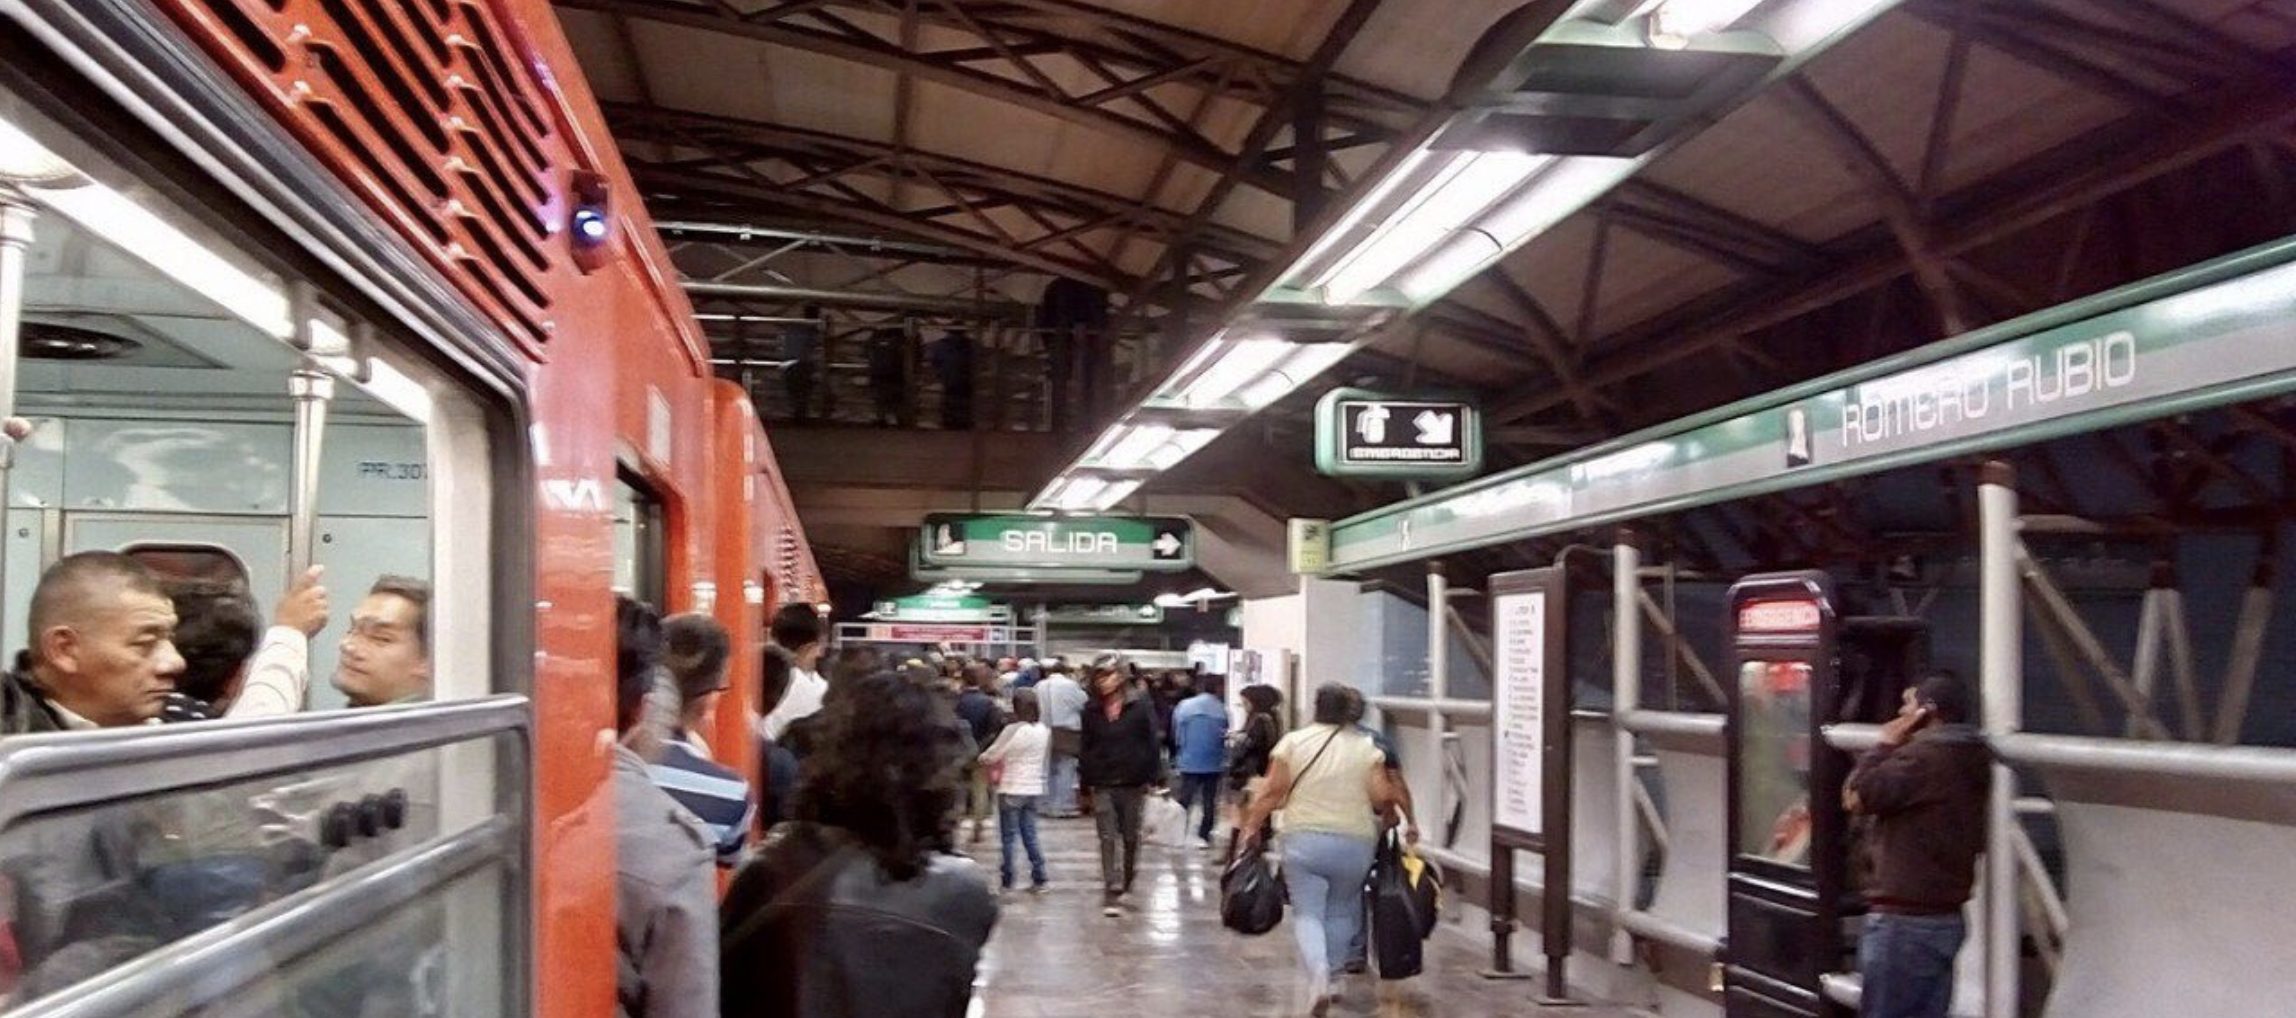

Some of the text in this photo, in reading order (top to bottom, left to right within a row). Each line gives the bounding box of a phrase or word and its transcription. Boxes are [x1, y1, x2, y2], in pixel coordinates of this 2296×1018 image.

[1841, 331, 2137, 447] ROMERO RUBIO
[1002, 529, 1118, 554] SALIDA
